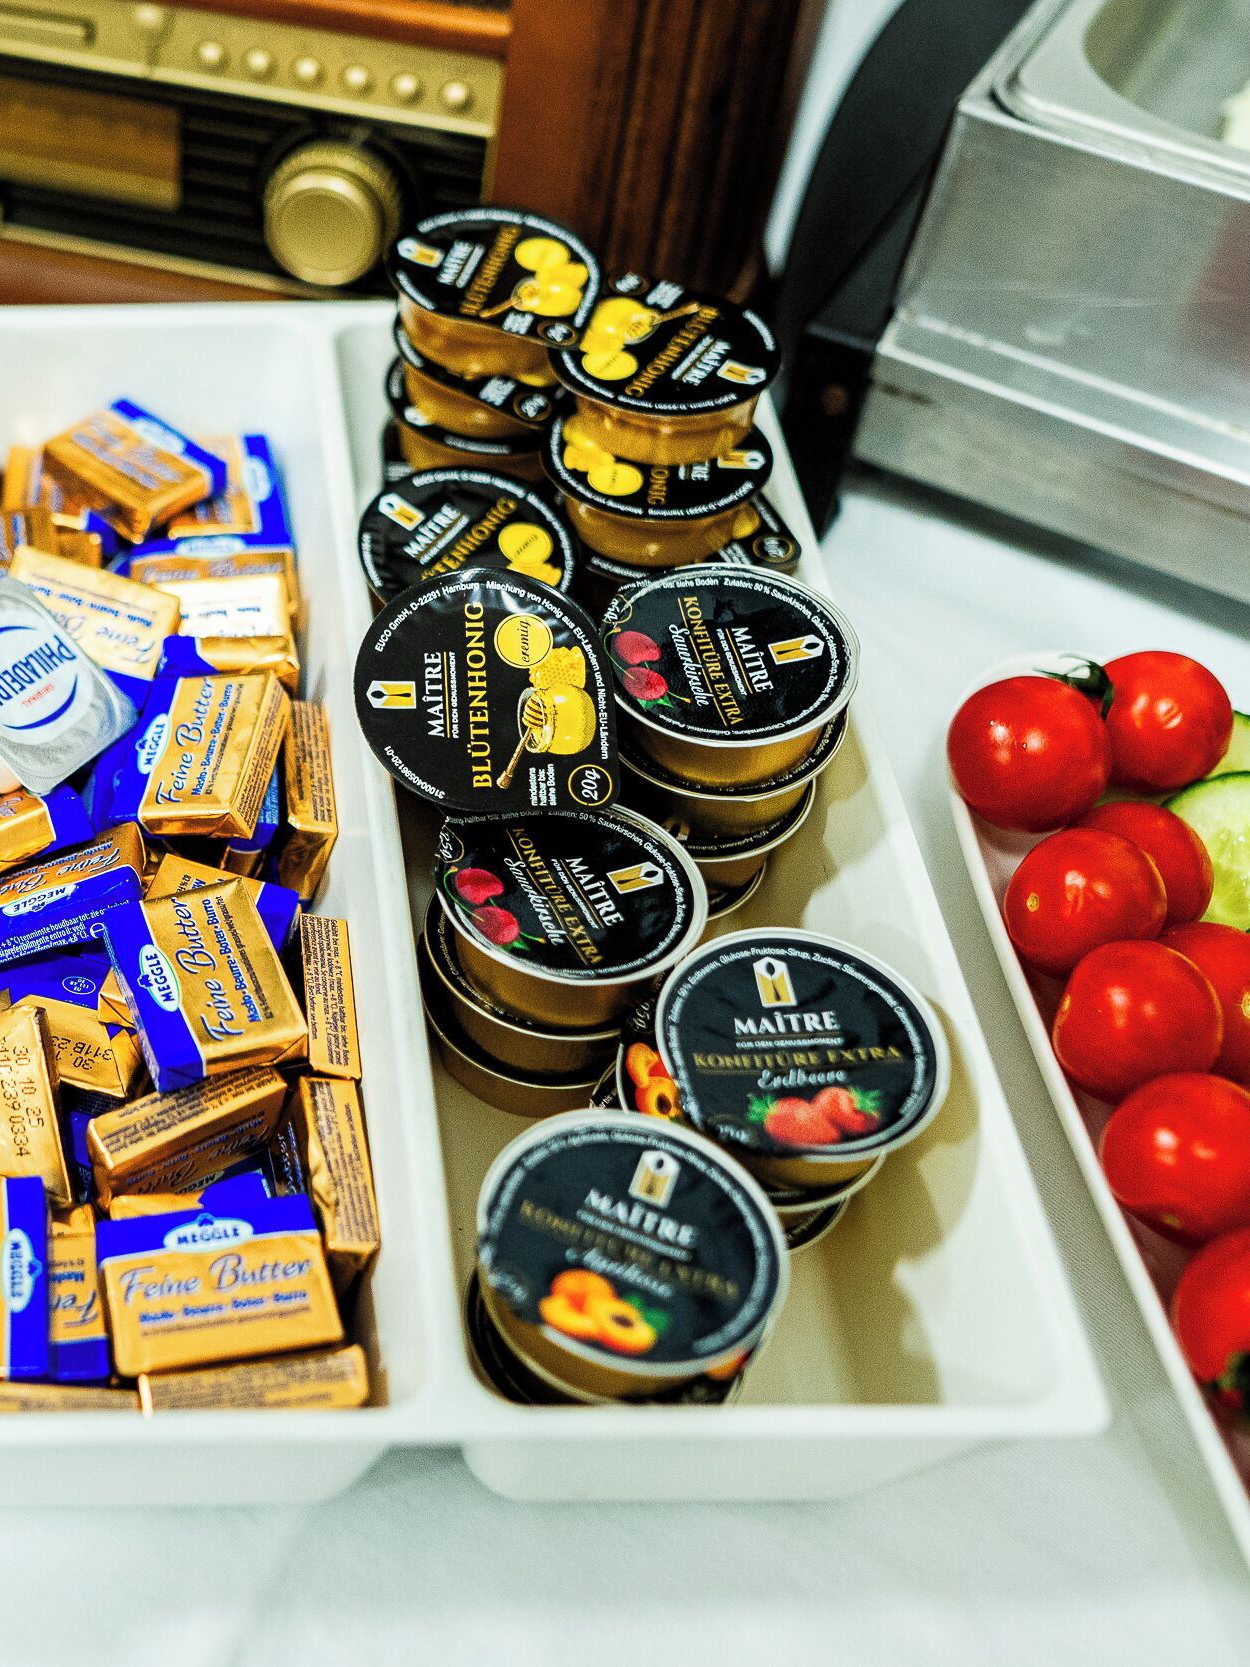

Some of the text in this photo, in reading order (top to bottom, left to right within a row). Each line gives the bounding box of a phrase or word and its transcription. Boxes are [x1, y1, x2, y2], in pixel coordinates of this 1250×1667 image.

[436, 240, 476, 285] MAÎTRE
[682, 339, 732, 386] MAÎTRE
[404, 503, 463, 560] MAÎTRE
[694, 577, 719, 588] Boden
[723, 578, 753, 590] Zutaten:
[753, 583, 764, 592] 50
[375, 581, 480, 652] EUCO GmbH, D-22291 Hamburg
[521, 619, 531, 663] cremig
[683, 595, 745, 726] KONFITÜRE EXTRA
[731, 626, 775, 693] MAÎTRE
[486, 580, 609, 760] Mischung von Honig aus EU-Ländern und Nicht-EU-Ländern
[668, 623, 711, 707] Sauerkirsche
[422, 651, 445, 738] MAÎTRE
[451, 708, 459, 723] DEN
[464, 601, 492, 788] BLÜTENHONIG
[144, 722, 166, 766] MEGGLE
[155, 678, 215, 805] Feine Butter
[200, 737, 218, 768] Beurre
[529, 767, 538, 806] mindestens
[538, 769, 547, 806] haltbar bis:
[547, 764, 556, 806] siehe Boden
[581, 768, 600, 800] 20g
[579, 813, 589, 821] 50
[597, 816, 644, 847] Sauerkirschen,
[58, 847, 122, 876] Feine
[13, 885, 67, 913] MEGGLE
[503, 857, 567, 947] Sauerkirsche
[512, 828, 605, 964] KONFITÜRE EXTRA
[565, 857, 625, 927] MAÎTRE
[19, 926, 52, 942] tenminste
[49, 916, 80, 932] houdbaar
[89, 909, 100, 919] zie
[71, 921, 86, 933] vedi
[171, 897, 244, 1042] Feine Butter
[201, 898, 262, 1023] Masło Beurre Boter Burro
[719, 947, 810, 963] Glukose-Fruktose-Sirup,
[145, 953, 175, 1002] MEGGLE
[733, 1008, 841, 1036] MAÎTRE
[693, 1046, 903, 1070] KONFITÜRE EXTRA
[757, 1068, 848, 1090] Erdbeere
[8, 1113, 32, 1158] 0334
[176, 1227, 240, 1244] MEGGLE
[10, 1240, 24, 1298] MEGGLE
[120, 1254, 312, 1306] Feine Butter
